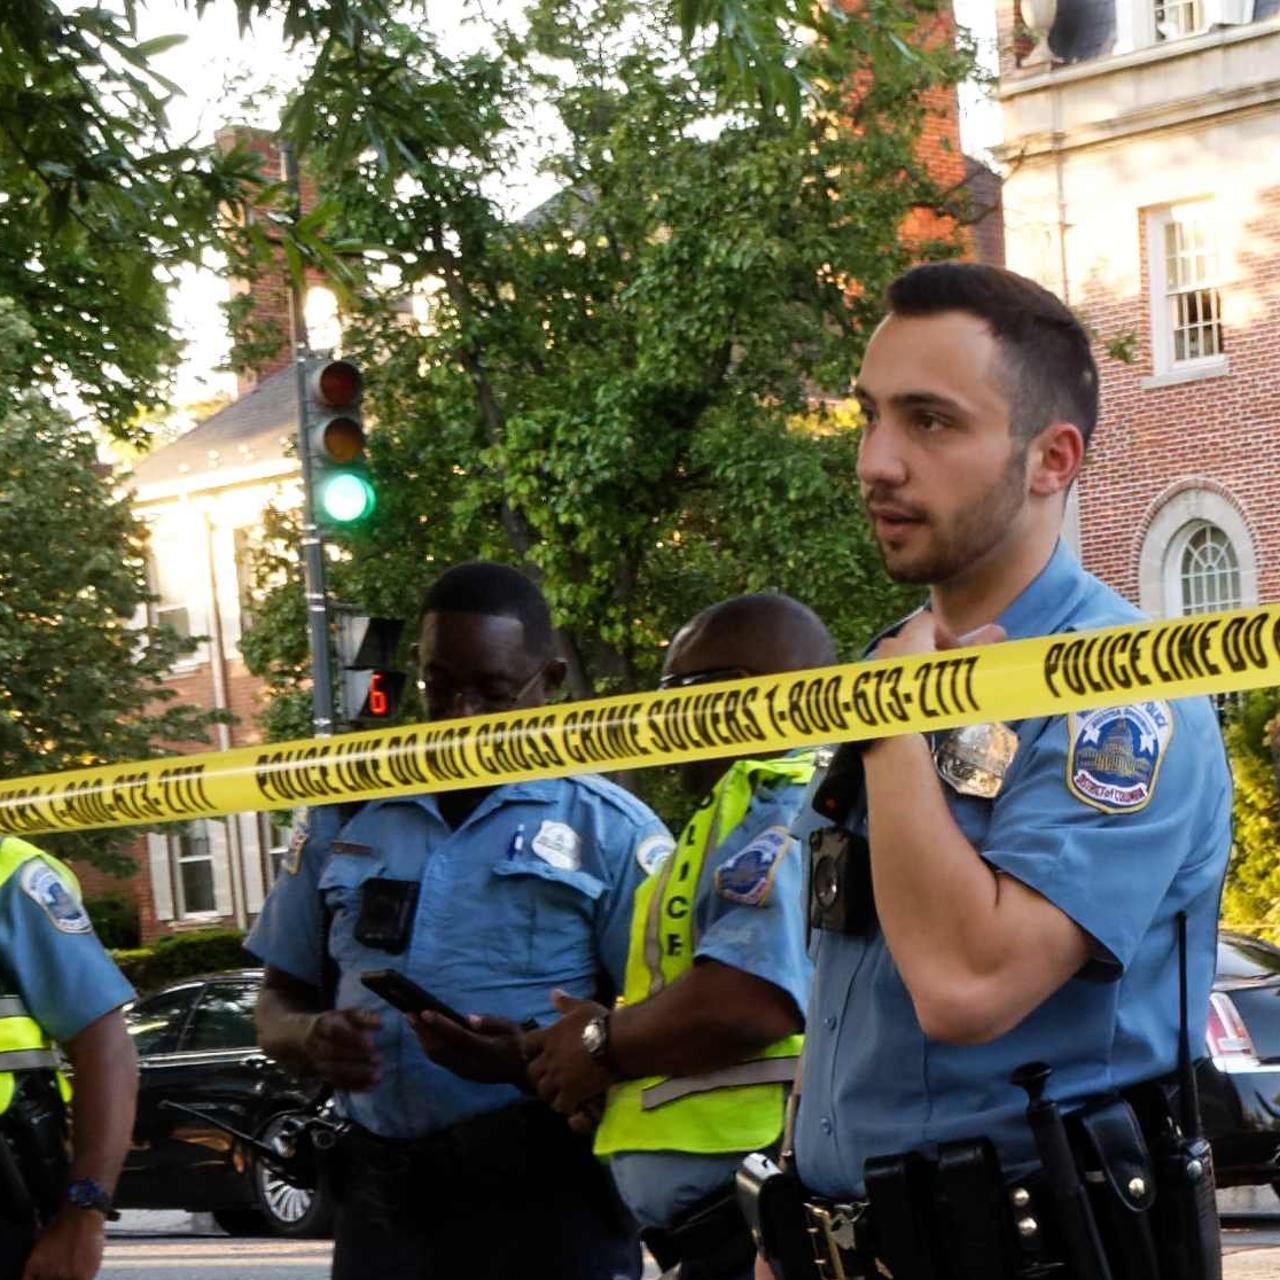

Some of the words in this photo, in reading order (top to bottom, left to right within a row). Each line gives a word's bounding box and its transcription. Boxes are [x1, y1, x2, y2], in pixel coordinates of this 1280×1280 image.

[1044, 630, 1153, 697] POLICE
[1151, 619, 1221, 682] LINE
[1221, 612, 1269, 672] DO
[255, 746, 342, 801] POLICE
[336, 739, 394, 791] LINE
[387, 733, 428, 784] DO
[425, 726, 479, 780] NOT
[475, 714, 565, 774] CROSS
[563, 703, 650, 763] CRIME
[648, 686, 766, 753] SOLVERS
[765, 656, 981, 737] 1-800-673-2777
